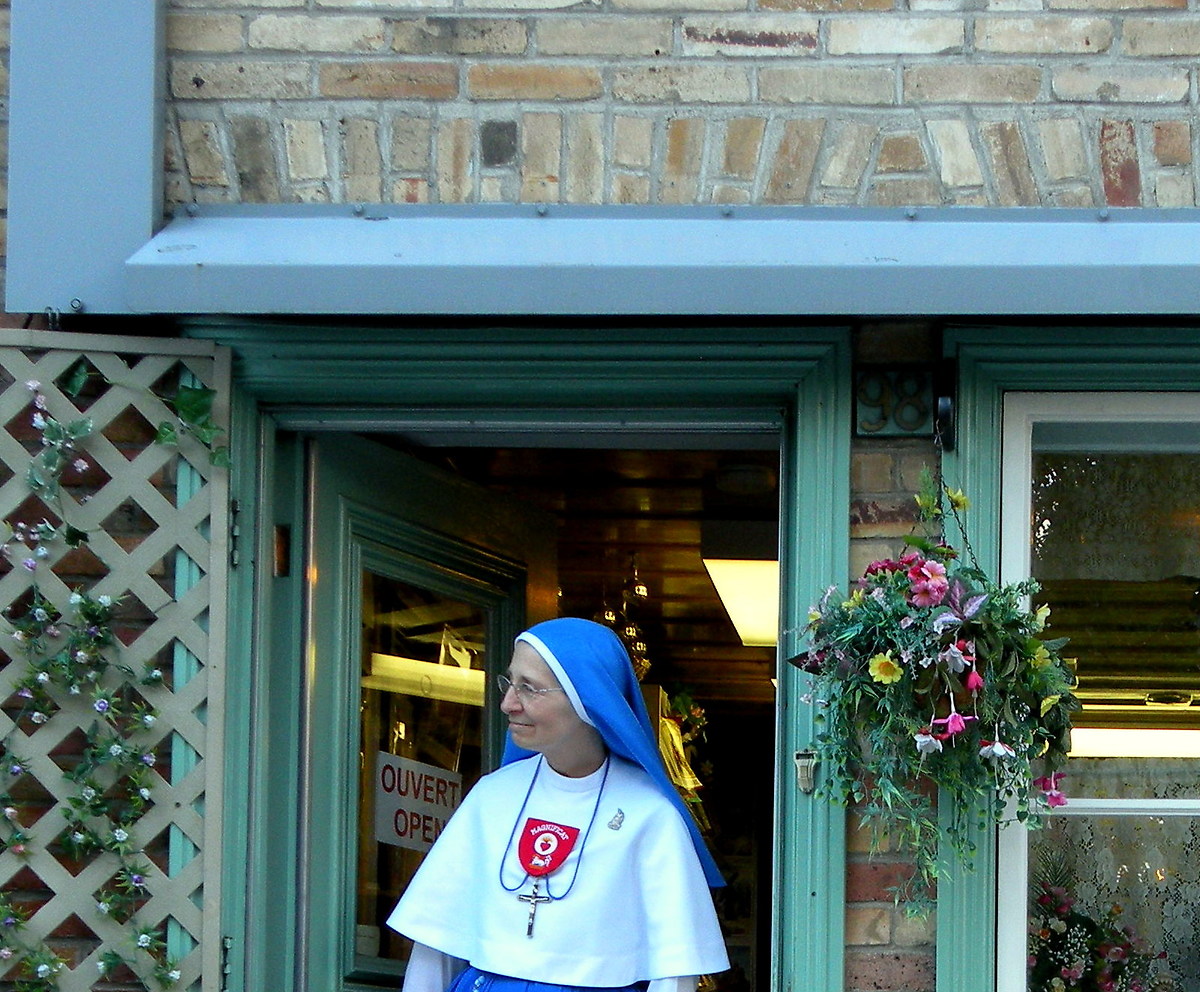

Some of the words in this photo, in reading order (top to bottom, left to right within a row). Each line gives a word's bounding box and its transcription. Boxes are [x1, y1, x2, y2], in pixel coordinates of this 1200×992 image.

[857, 370, 928, 432] 98
[381, 764, 459, 808] OUVERT
[394, 808, 446, 843] OPEN
[530, 824, 569, 841] MAGNIFICAT
